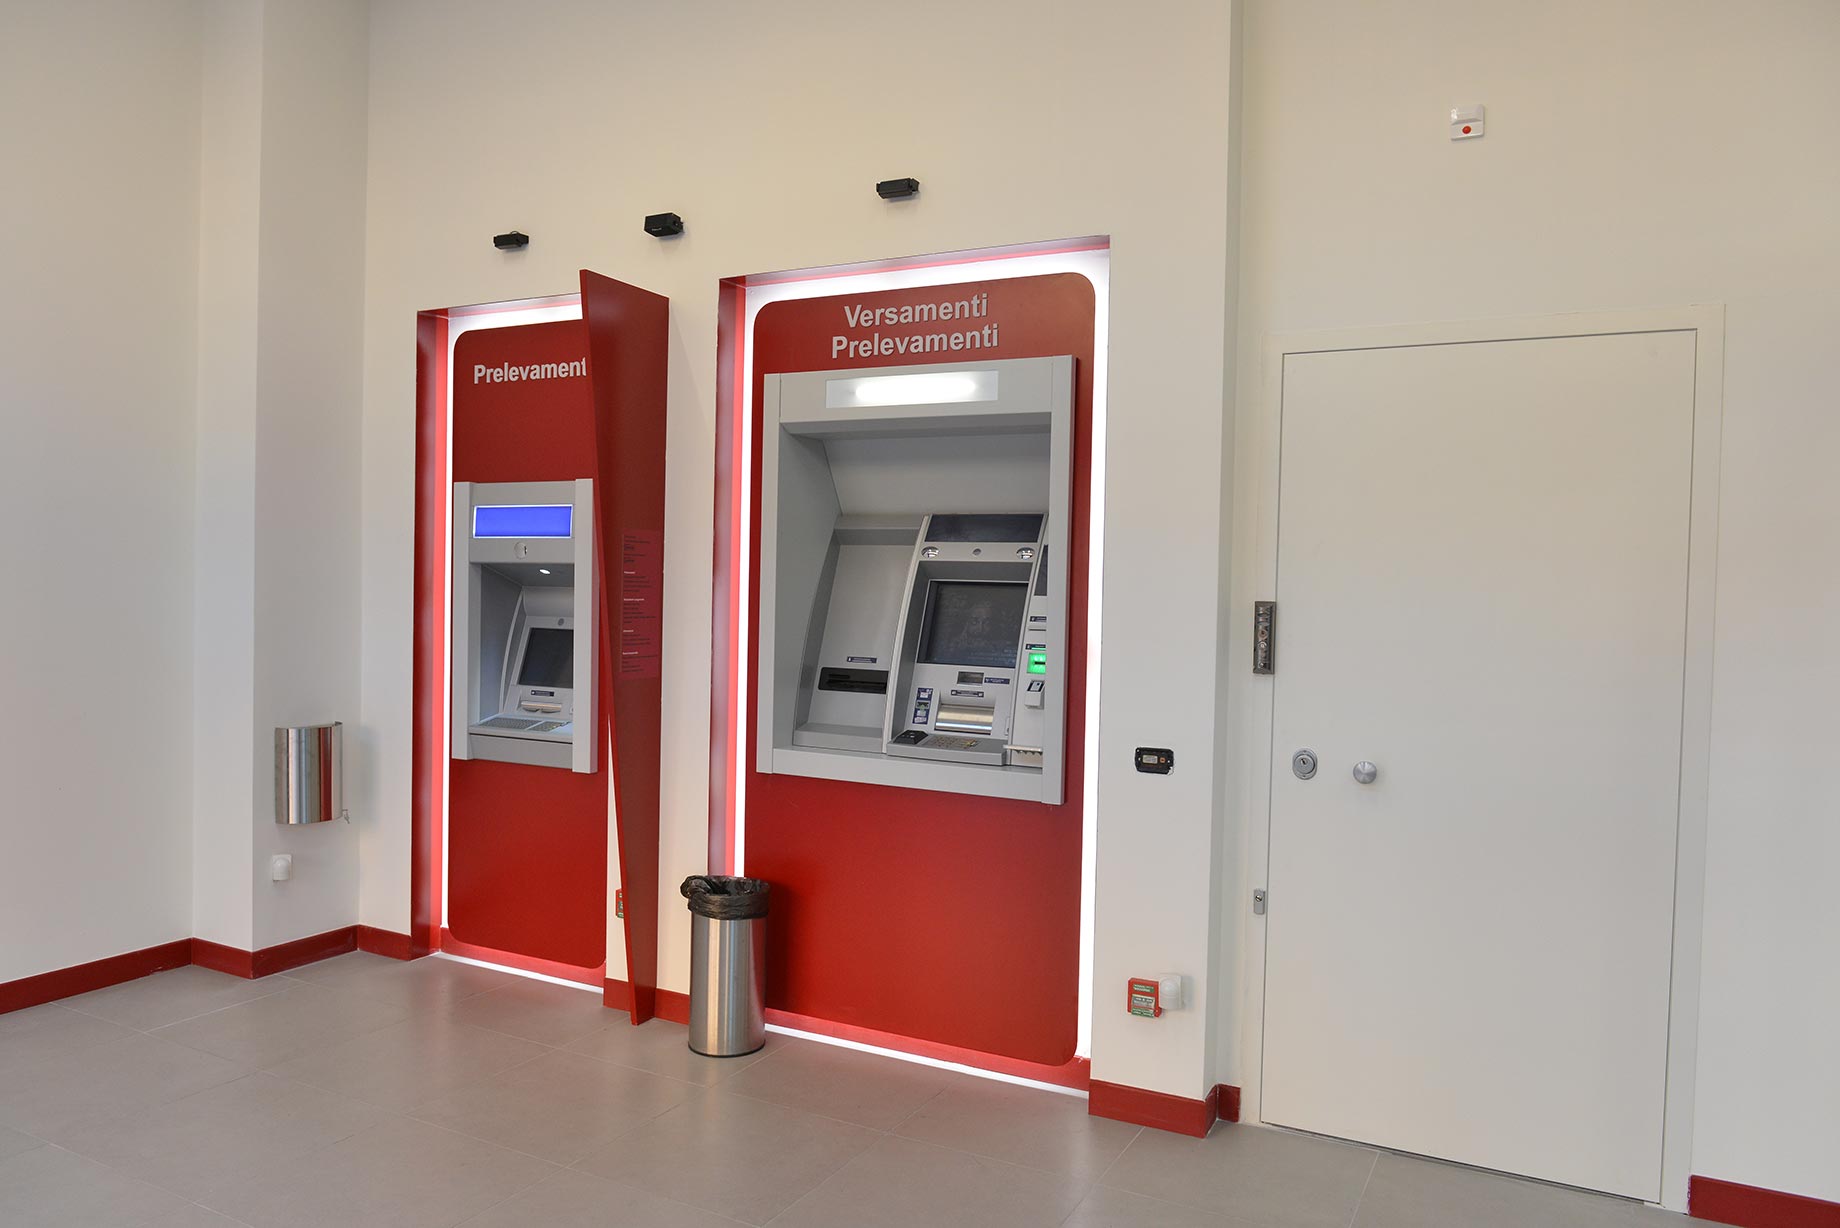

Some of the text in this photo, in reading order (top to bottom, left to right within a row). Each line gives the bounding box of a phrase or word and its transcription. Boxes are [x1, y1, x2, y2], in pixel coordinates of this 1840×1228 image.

[844, 293, 988, 328] Versamenti
[832, 323, 999, 359] Prelevamenti
[474, 357, 587, 385] Prelevament
